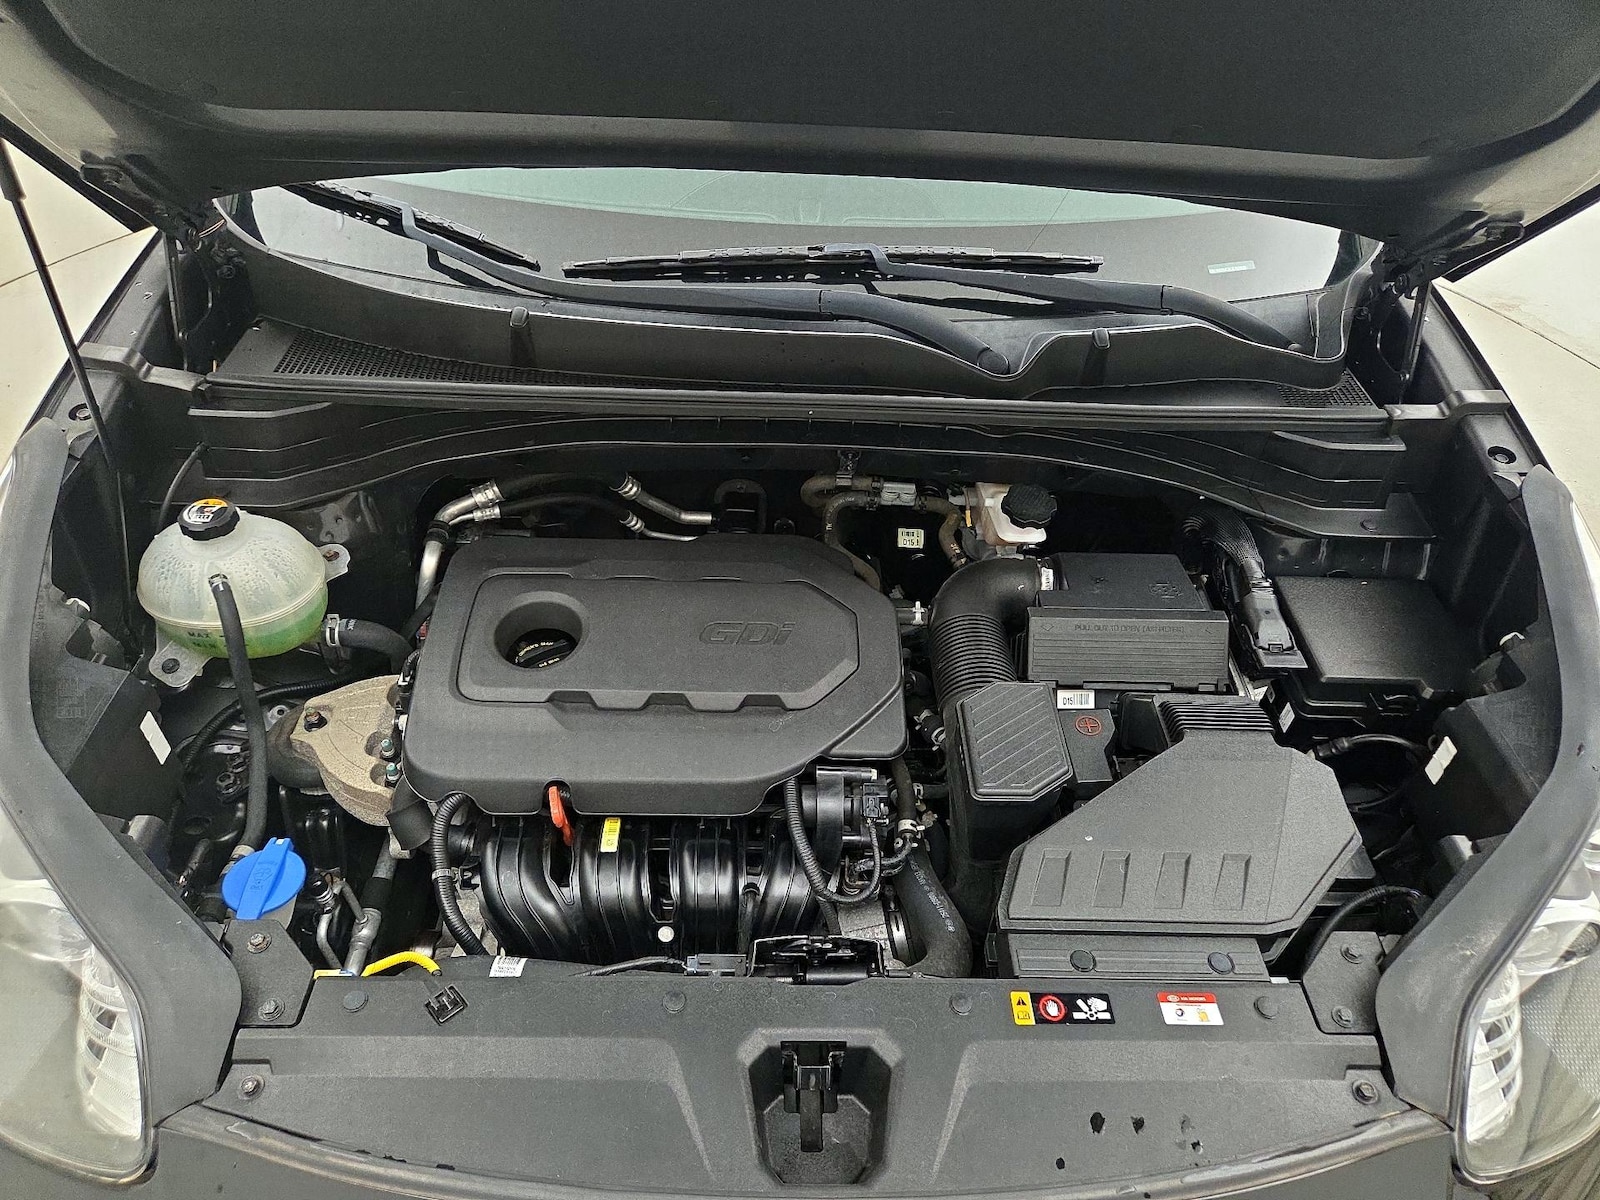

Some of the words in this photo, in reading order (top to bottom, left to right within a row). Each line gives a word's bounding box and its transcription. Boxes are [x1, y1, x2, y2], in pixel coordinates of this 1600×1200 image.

[699, 621, 796, 645] GDi
[1094, 624, 1108, 632] OUT
[1121, 625, 1140, 633] OPEN
[187, 631, 212, 639] MAX
